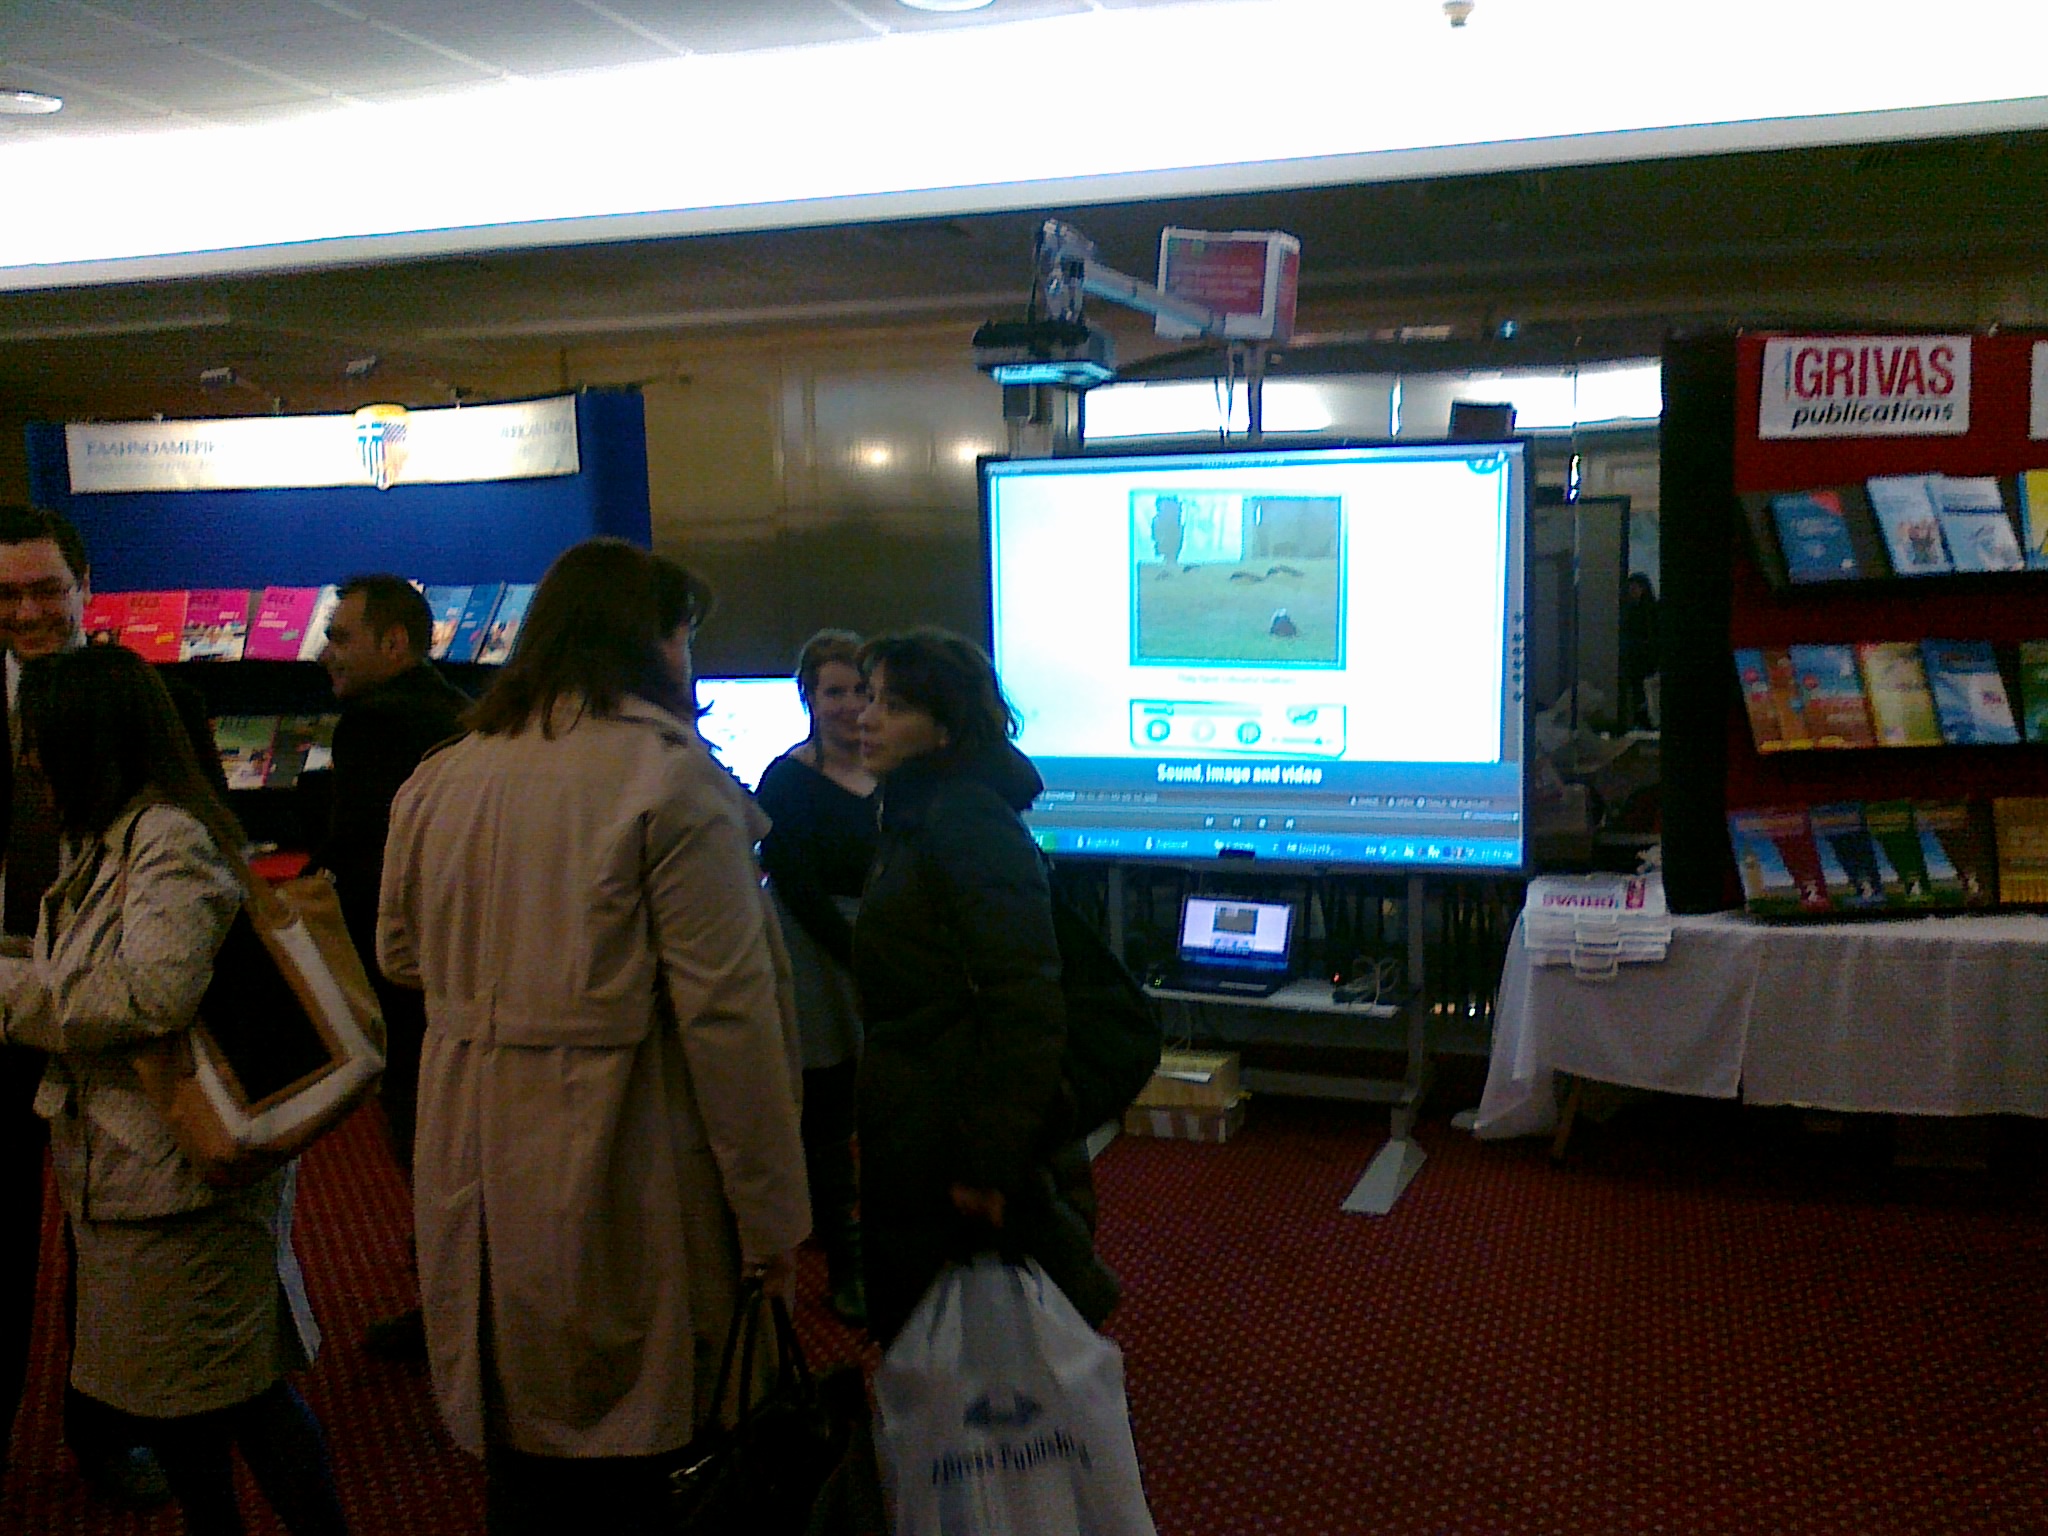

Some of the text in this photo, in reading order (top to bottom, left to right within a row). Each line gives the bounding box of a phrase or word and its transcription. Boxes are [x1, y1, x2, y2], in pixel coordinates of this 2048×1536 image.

[1793, 346, 1956, 400] GRIVAS
[1790, 401, 1954, 430] publications
[1157, 762, 1204, 784] Sound,
[1252, 765, 1281, 784] and
[1281, 765, 1323, 785] video
